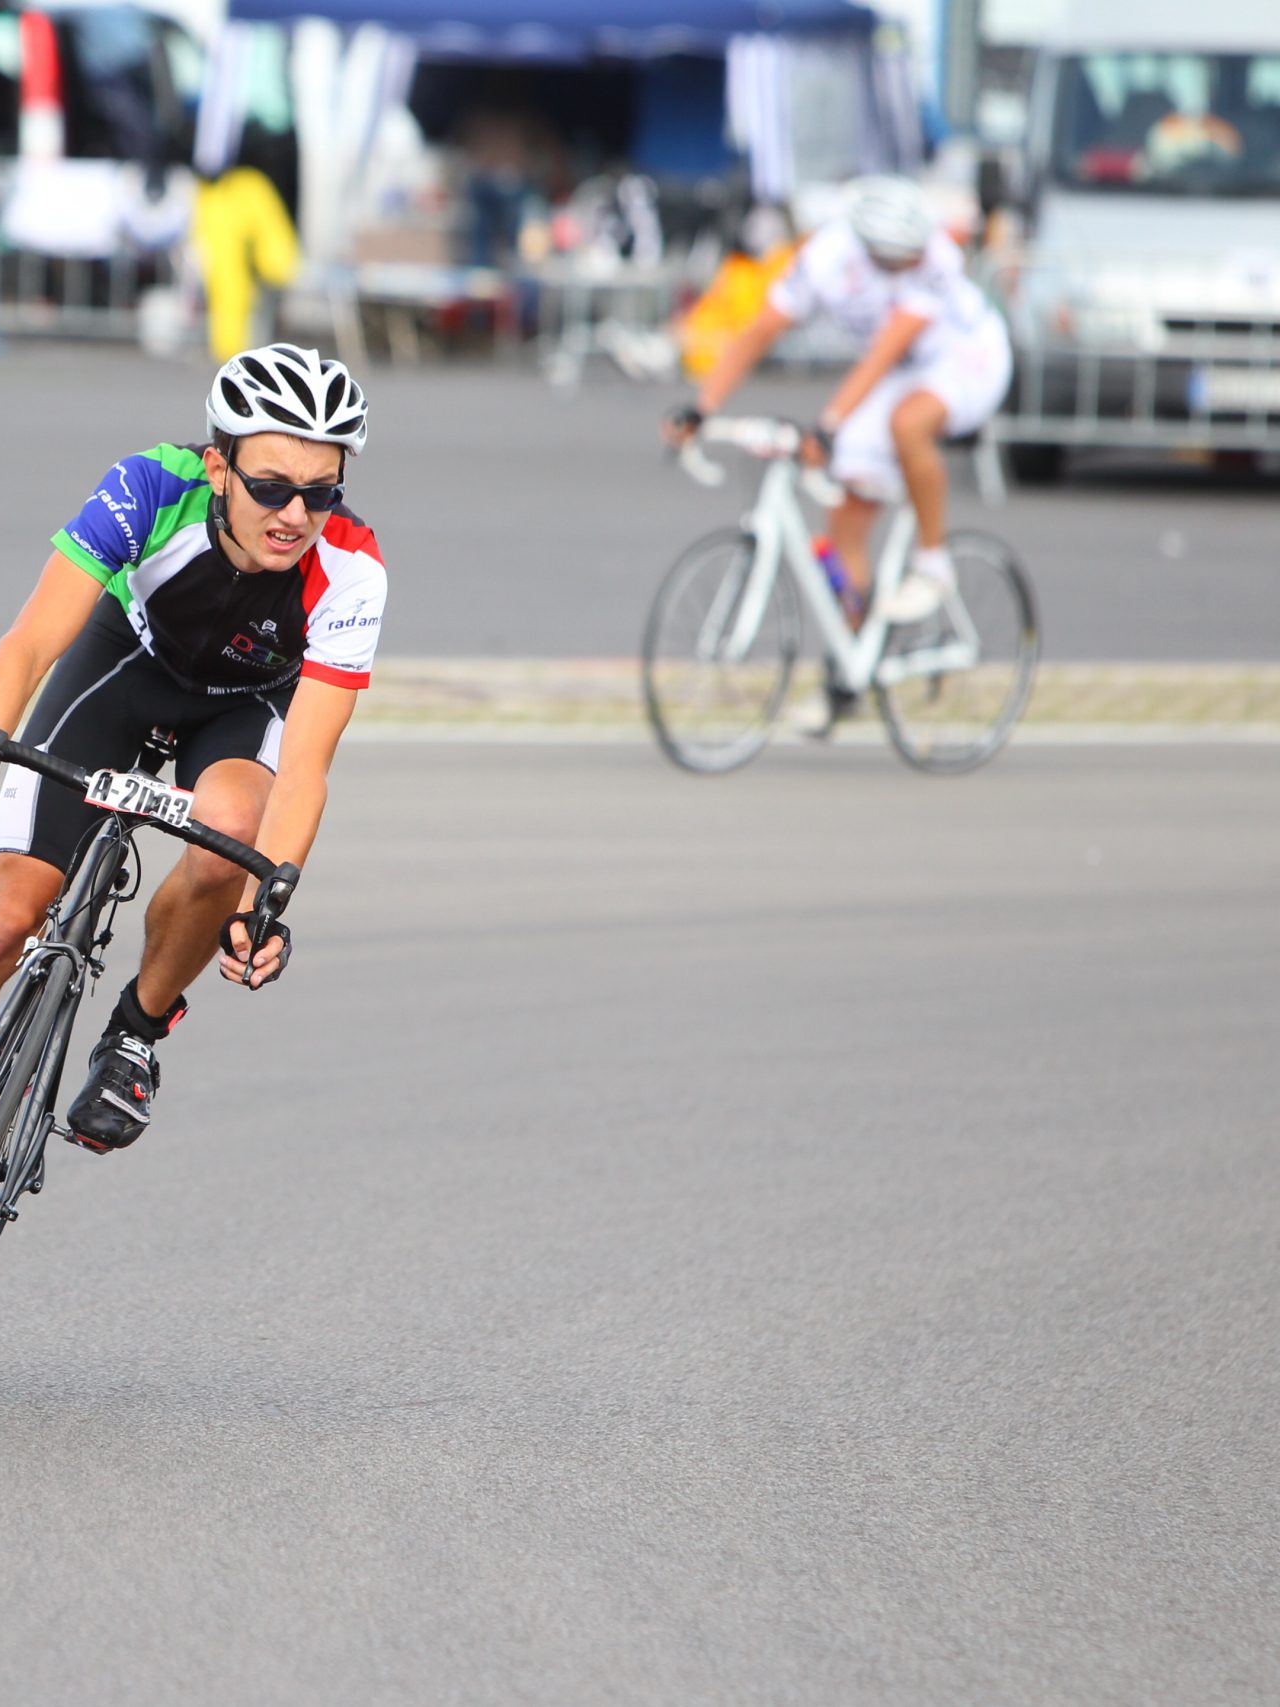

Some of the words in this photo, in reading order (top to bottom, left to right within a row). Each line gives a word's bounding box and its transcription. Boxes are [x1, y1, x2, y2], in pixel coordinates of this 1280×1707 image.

[98, 489, 122, 512] rad
[114, 512, 133, 538] am
[328, 616, 356, 631] rad
[358, 617, 379, 627] am
